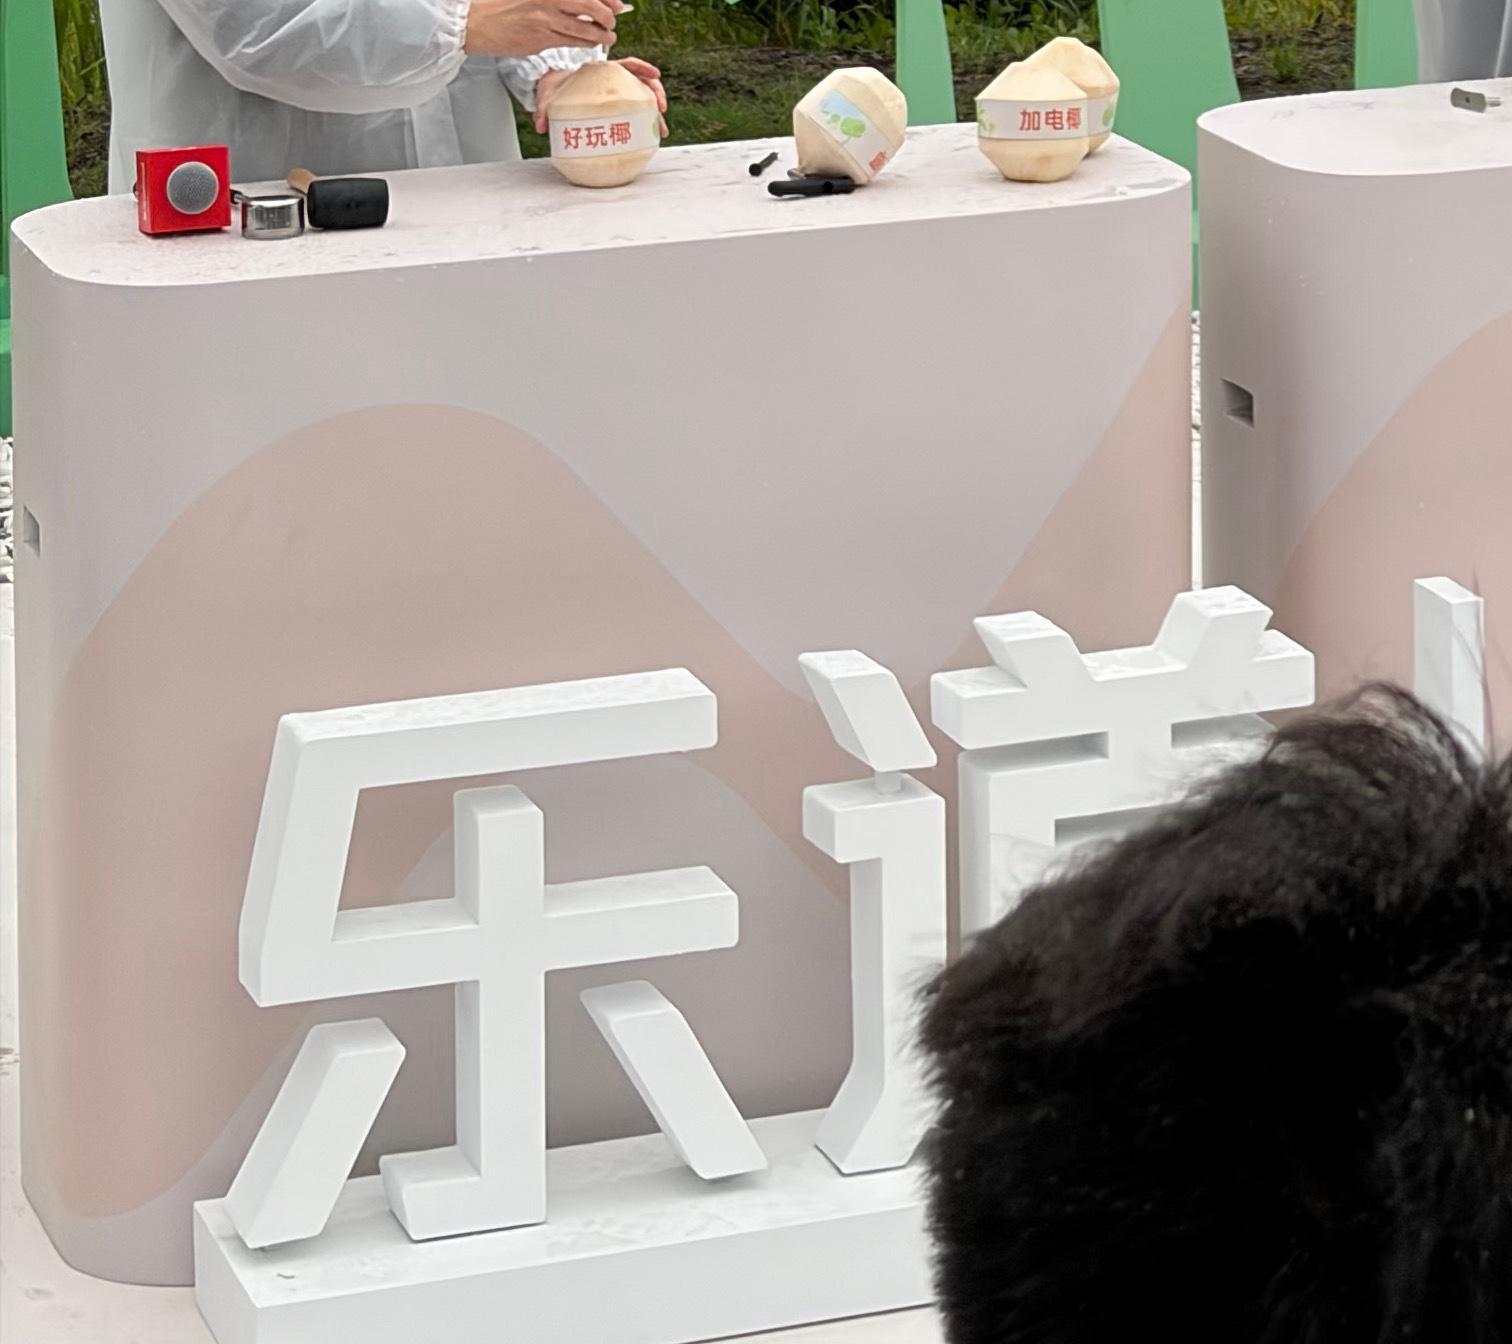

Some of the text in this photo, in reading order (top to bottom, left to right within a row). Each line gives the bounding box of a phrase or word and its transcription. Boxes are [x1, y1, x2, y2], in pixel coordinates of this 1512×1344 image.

[1019, 107, 1081, 131] 加电椰
[563, 121, 632, 149] 好玩椰
